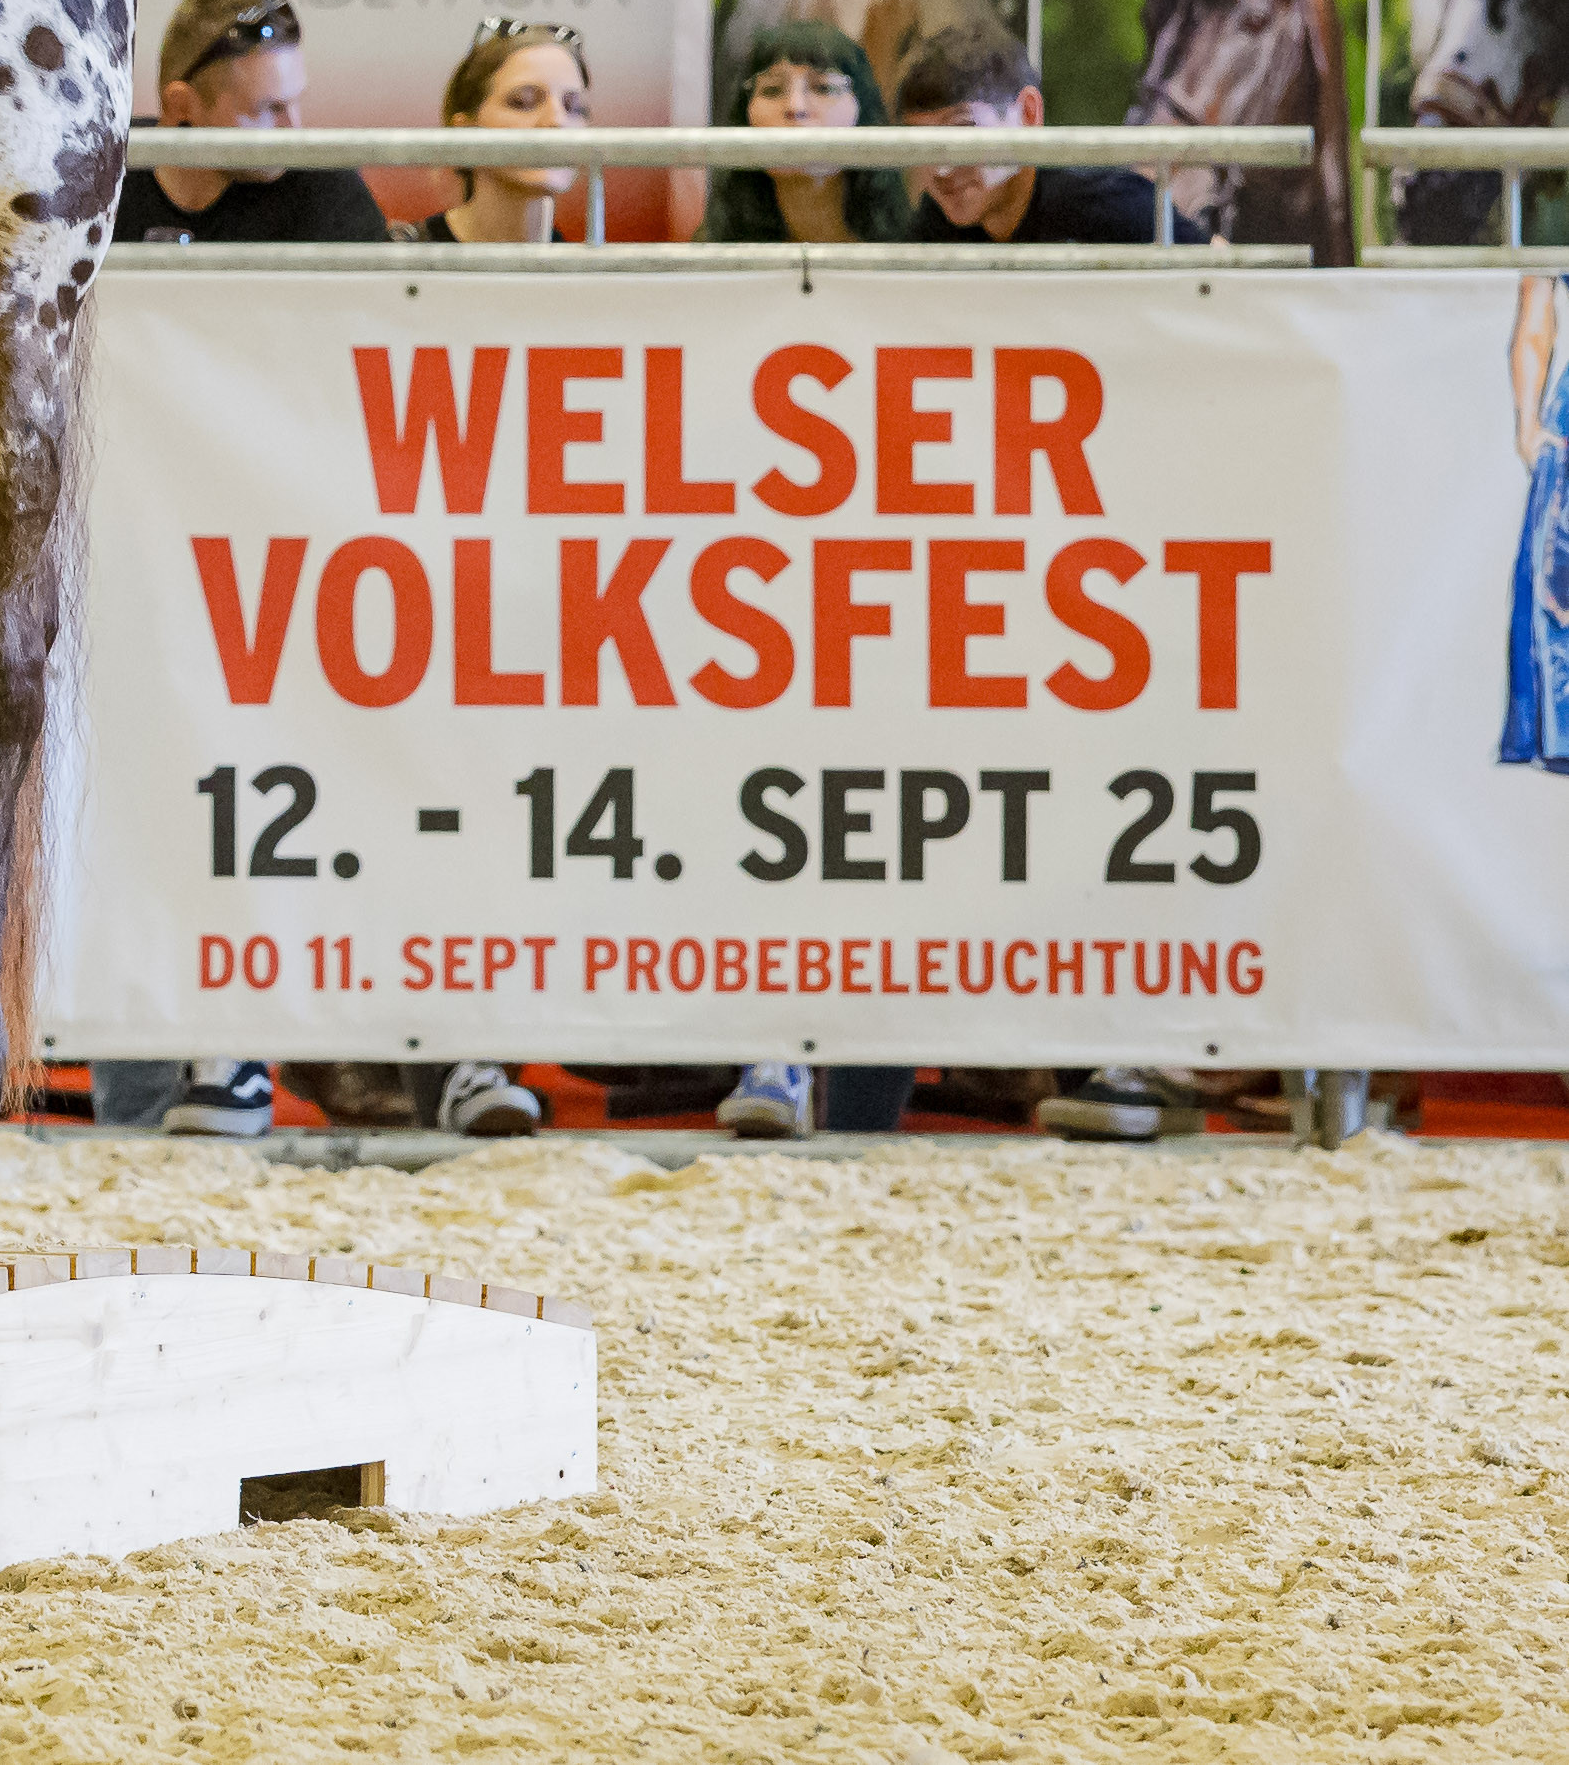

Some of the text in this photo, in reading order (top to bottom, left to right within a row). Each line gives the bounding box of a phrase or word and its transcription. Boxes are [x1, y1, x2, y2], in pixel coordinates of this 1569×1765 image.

[352, 343, 1105, 518] WELSER
[190, 535, 1273, 712] VOLKSFEST
[198, 765, 1262, 885] 12. - 14. SEPT 25
[200, 935, 1266, 996] DO 11. SEPT PROBEBELEUCHTUNG
